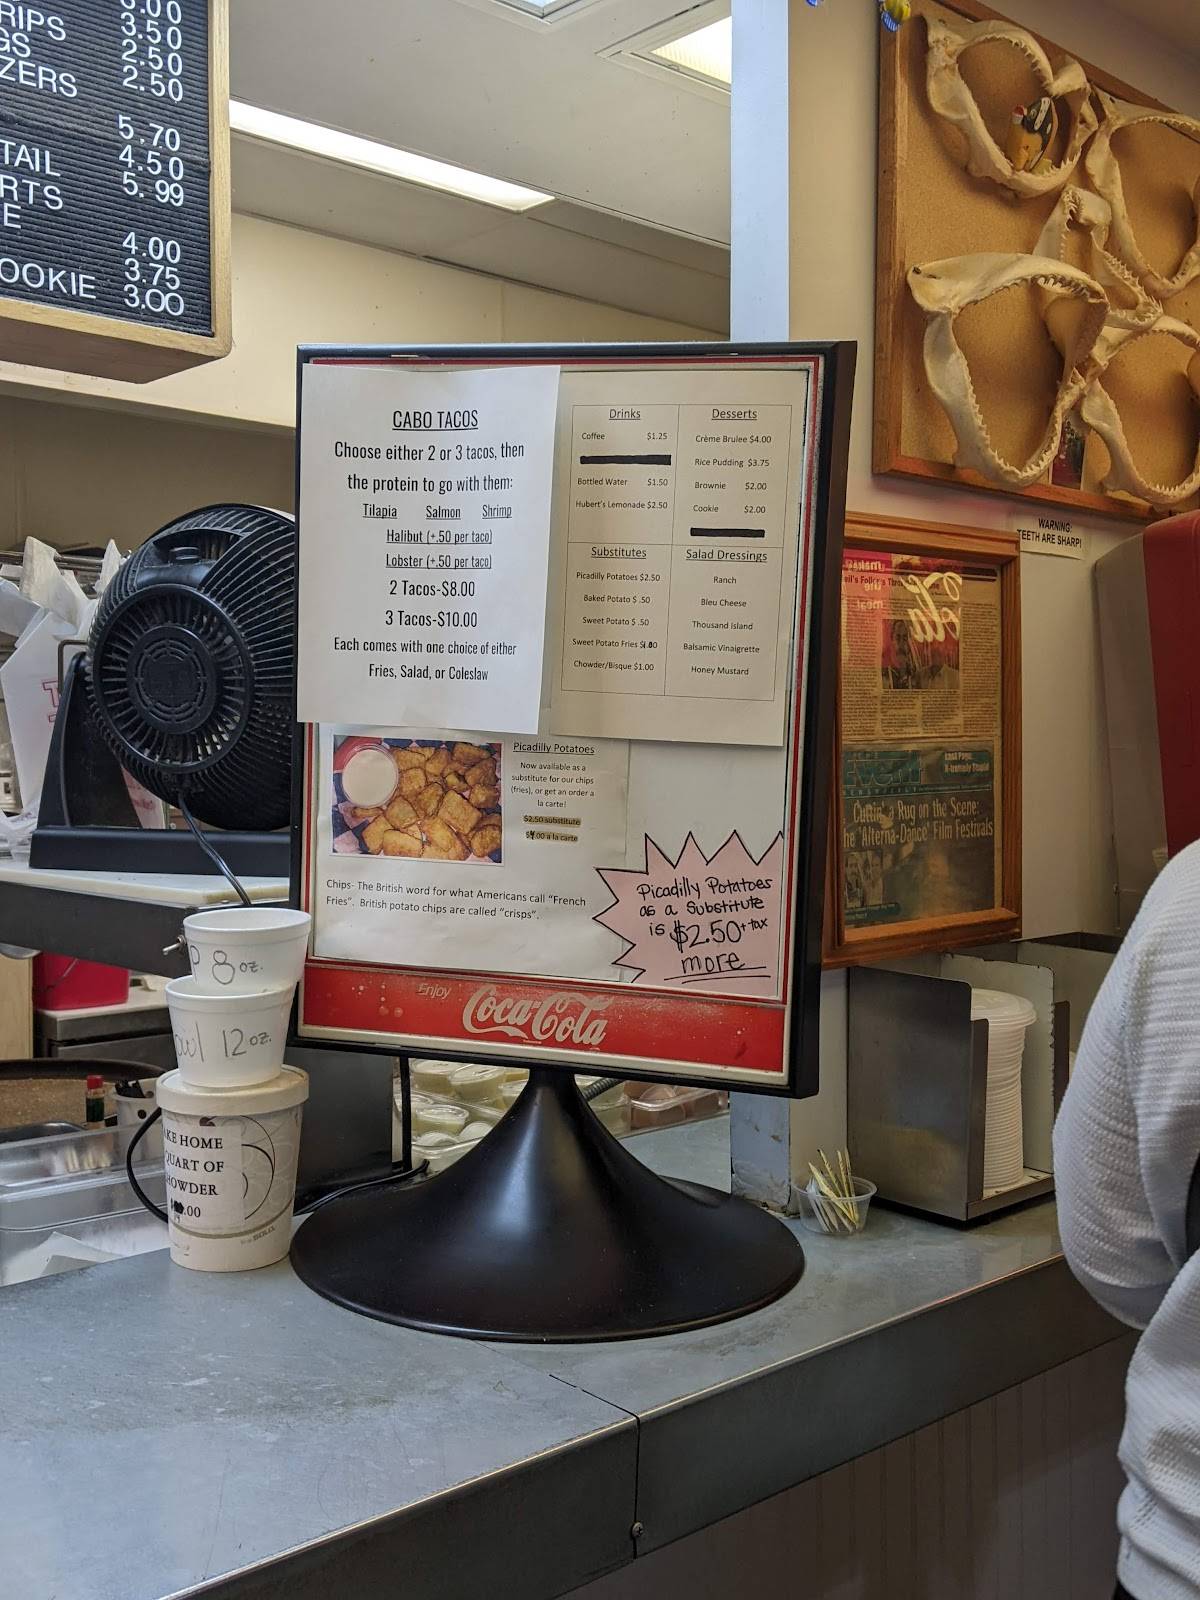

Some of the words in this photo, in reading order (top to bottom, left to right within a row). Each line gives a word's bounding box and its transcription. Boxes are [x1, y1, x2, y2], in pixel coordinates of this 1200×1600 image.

[120, 12, 182, 50] 3.50
[121, 39, 183, 76] 2.50
[122, 65, 183, 101] 2.50
[118, 114, 181, 151] 5.70
[119, 144, 184, 180] 4.50
[122, 172, 185, 207] 5.99
[122, 232, 181, 264] 4.00
[124, 258, 181, 290] 3.75
[124, 284, 185, 316] 3.00
[392, 411, 432, 430] CABO
[437, 410, 478, 429] TACOS
[609, 409, 641, 420] Drinks
[712, 409, 757, 420] Desserts
[581, 432, 605, 440] Coffee
[647, 432, 667, 441] $1.25
[695, 435, 720, 443] Crème
[723, 435, 747, 443] Brulee
[750, 435, 772, 444] $4.00
[334, 441, 381, 460] Choose
[386, 445, 424, 461] either
[428, 445, 436, 461] 2
[440, 448, 451, 461] or
[455, 445, 463, 461] 3
[466, 446, 497, 461] tacos,
[501, 442, 524, 458] then
[713, 459, 743, 468] Pudding
[748, 459, 769, 467] $3.75
[347, 474, 368, 490] the
[373, 476, 418, 493] protein
[423, 477, 435, 491] to
[438, 480, 452, 494] go
[457, 476, 479, 491] with
[483, 475, 513, 491] them:
[577, 478, 603, 486] Bottled
[606, 478, 627, 486] Water
[648, 478, 668, 487] $1.50
[695, 481, 726, 490] Brownie
[745, 482, 767, 490] $2.00
[363, 503, 397, 519] Tilapia
[426, 505, 461, 520] Salmon
[482, 504, 512, 519] Shrimp
[576, 501, 606, 509] Hubert's
[608, 501, 645, 509] Lemonade
[647, 501, 668, 510] $2.50
[693, 505, 719, 513] Cookie
[744, 505, 766, 514] $2.00
[1038, 518, 1072, 534] WARNING:
[386, 529, 423, 543] Halibut
[427, 530, 451, 544] (+.50
[454, 532, 469, 545] per
[471, 530, 492, 543] taco)
[1017, 529, 1039, 542] TEETH
[1042, 533, 1056, 544] ARE
[1058, 535, 1082, 549] SHARP!
[591, 547, 647, 559] Substitutes
[686, 550, 714, 561] Salad
[717, 550, 768, 562] Dressings
[386, 554, 423, 568] Lobster
[427, 555, 451, 568] (+.50
[454, 556, 469, 569] per
[471, 555, 492, 568] taco)
[576, 572, 605, 581] Picadilly
[607, 572, 638, 581] Potatoes
[640, 573, 660, 582] $2.50
[713, 576, 737, 584] Ranch
[389, 580, 397, 595] 2
[402, 580, 475, 598] Tacos-$8.00
[584, 594, 605, 602] Baked
[607, 595, 631, 603] Potato
[720, 599, 747, 608] Cheese
[385, 610, 393, 625] 3
[398, 611, 477, 628] Tacos-$10.00
[582, 616, 604, 625] Sweet
[606, 617, 629, 625] Potato
[692, 620, 729, 630] Thousand
[731, 621, 753, 630] Island
[334, 637, 359, 650] Each
[363, 640, 397, 652] comes
[400, 640, 423, 653] with
[426, 642, 444, 653] one
[448, 641, 477, 654] choice
[480, 642, 489, 654] of
[491, 642, 516, 655] either
[572, 638, 594, 647] Sweet
[596, 639, 620, 648] Potato
[621, 640, 638, 648] Fries
[683, 643, 715, 652] Balsamic
[718, 644, 760, 654] Vinaigrette
[369, 664, 397, 679] Fries,
[401, 665, 431, 680] Salad,
[435, 668, 445, 679] or
[449, 666, 488, 680] Coleslaw
[574, 660, 632, 671] Chowder/Bisque
[634, 662, 654, 671] $1.00
[691, 665, 715, 676] Honey
[717, 666, 749, 676] Mustard
[513, 742, 551, 754] Picadilly
[554, 743, 595, 755] Potatoes
[888, 807, 894, 818] a
[897, 799, 916, 825] Rug
[919, 805, 929, 817] on
[933, 798, 947, 817] the
[950, 797, 979, 817] Scene:
[933, 821, 952, 841] Film
[955, 817, 993, 840] Festivals
[326, 879, 355, 890] Chips-
[357, 881, 374, 892] The
[376, 882, 403, 893] British
[406, 885, 430, 896] word
[432, 886, 447, 897] for
[449, 887, 473, 898] what
[476, 889, 527, 902] Americans
[529, 892, 546, 903] call
[636, 876, 701, 899] Picadilly
[705, 876, 773, 895] Potatoes
[360, 898, 387, 910] British
[389, 901, 420, 912] potato
[422, 903, 447, 915] chips
[449, 906, 466, 915] are
[468, 906, 497, 917] called
[639, 905, 656, 917] as
[665, 906, 678, 915] a
[649, 922, 666, 936] is
[670, 920, 741, 953] $2.50
[681, 952, 746, 974] more
[418, 983, 451, 999] Enjoy
[462, 984, 612, 1046] Coca-Cola
[180, 1135, 223, 1149] HOME
[203, 1160, 225, 1173] OF
